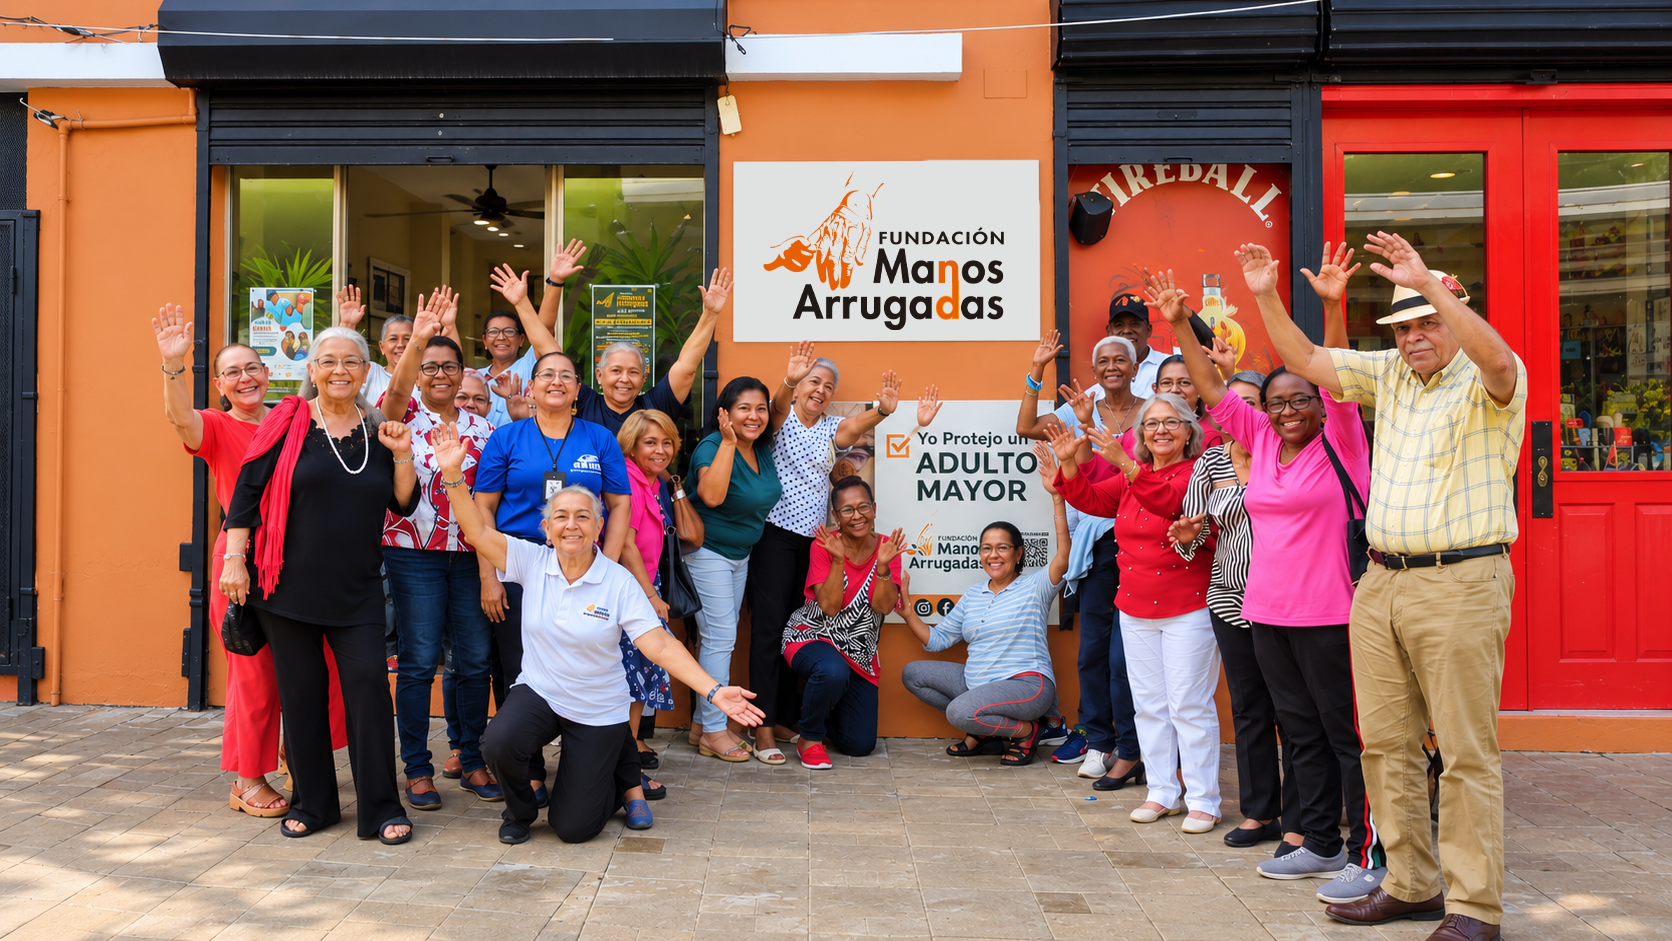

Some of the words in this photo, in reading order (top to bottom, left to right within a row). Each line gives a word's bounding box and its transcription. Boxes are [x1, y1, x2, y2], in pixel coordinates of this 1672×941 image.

[878, 227, 1005, 245] FUNDACIÓN
[873, 248, 1004, 284] Manos
[793, 283, 1004, 331] Arrugadas
[917, 432, 938, 445] Yo
[943, 432, 1003, 448] Protejo
[1008, 435, 1028, 445] un
[915, 452, 1038, 474] ADULTO
[917, 480, 1027, 501] MAYOR
[938, 534, 978, 542] FUNDACIÓN
[937, 542, 981, 555] Mano
